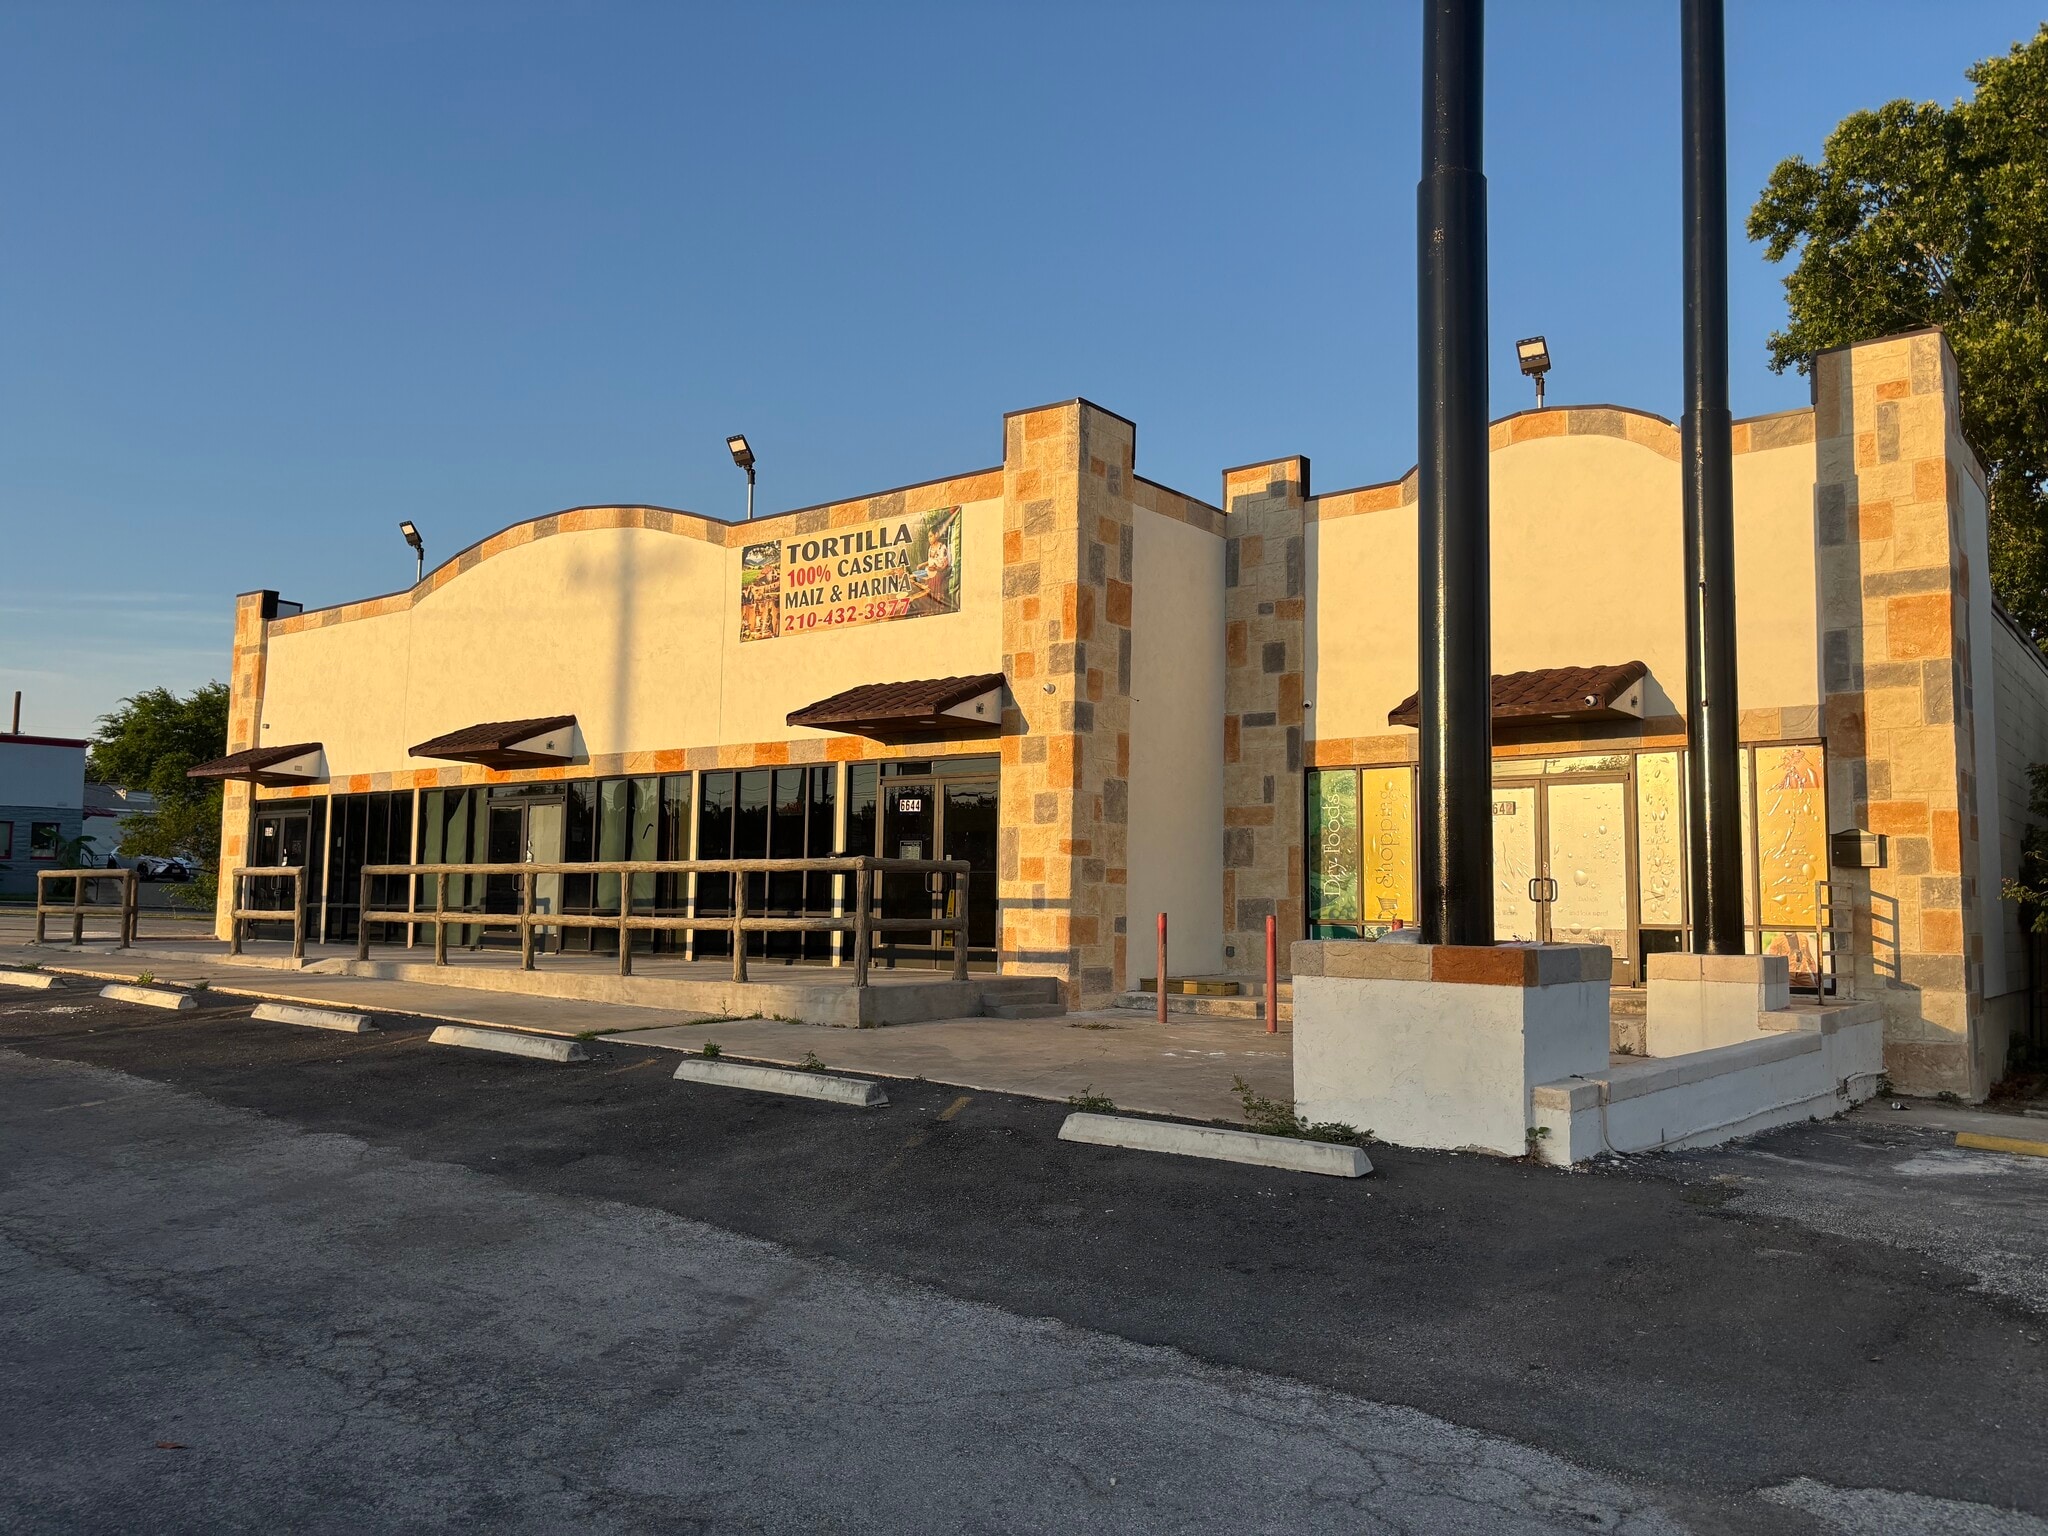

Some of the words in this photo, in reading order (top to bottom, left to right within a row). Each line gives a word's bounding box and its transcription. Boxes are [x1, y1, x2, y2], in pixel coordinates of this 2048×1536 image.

[786, 523, 913, 564] TORTILLA
[787, 564, 831, 588] 100%
[837, 549, 910, 577] CASERA
[785, 587, 824, 610] MAIZ
[829, 585, 842, 602] &
[848, 573, 912, 600] HARINA
[784, 598, 911, 631] 210-432-3877
[900, 800, 920, 811] 6644
[1322, 793, 1341, 853] Foods
[1375, 789, 1400, 888] Shopping
[1323, 857, 1346, 896] Dry
